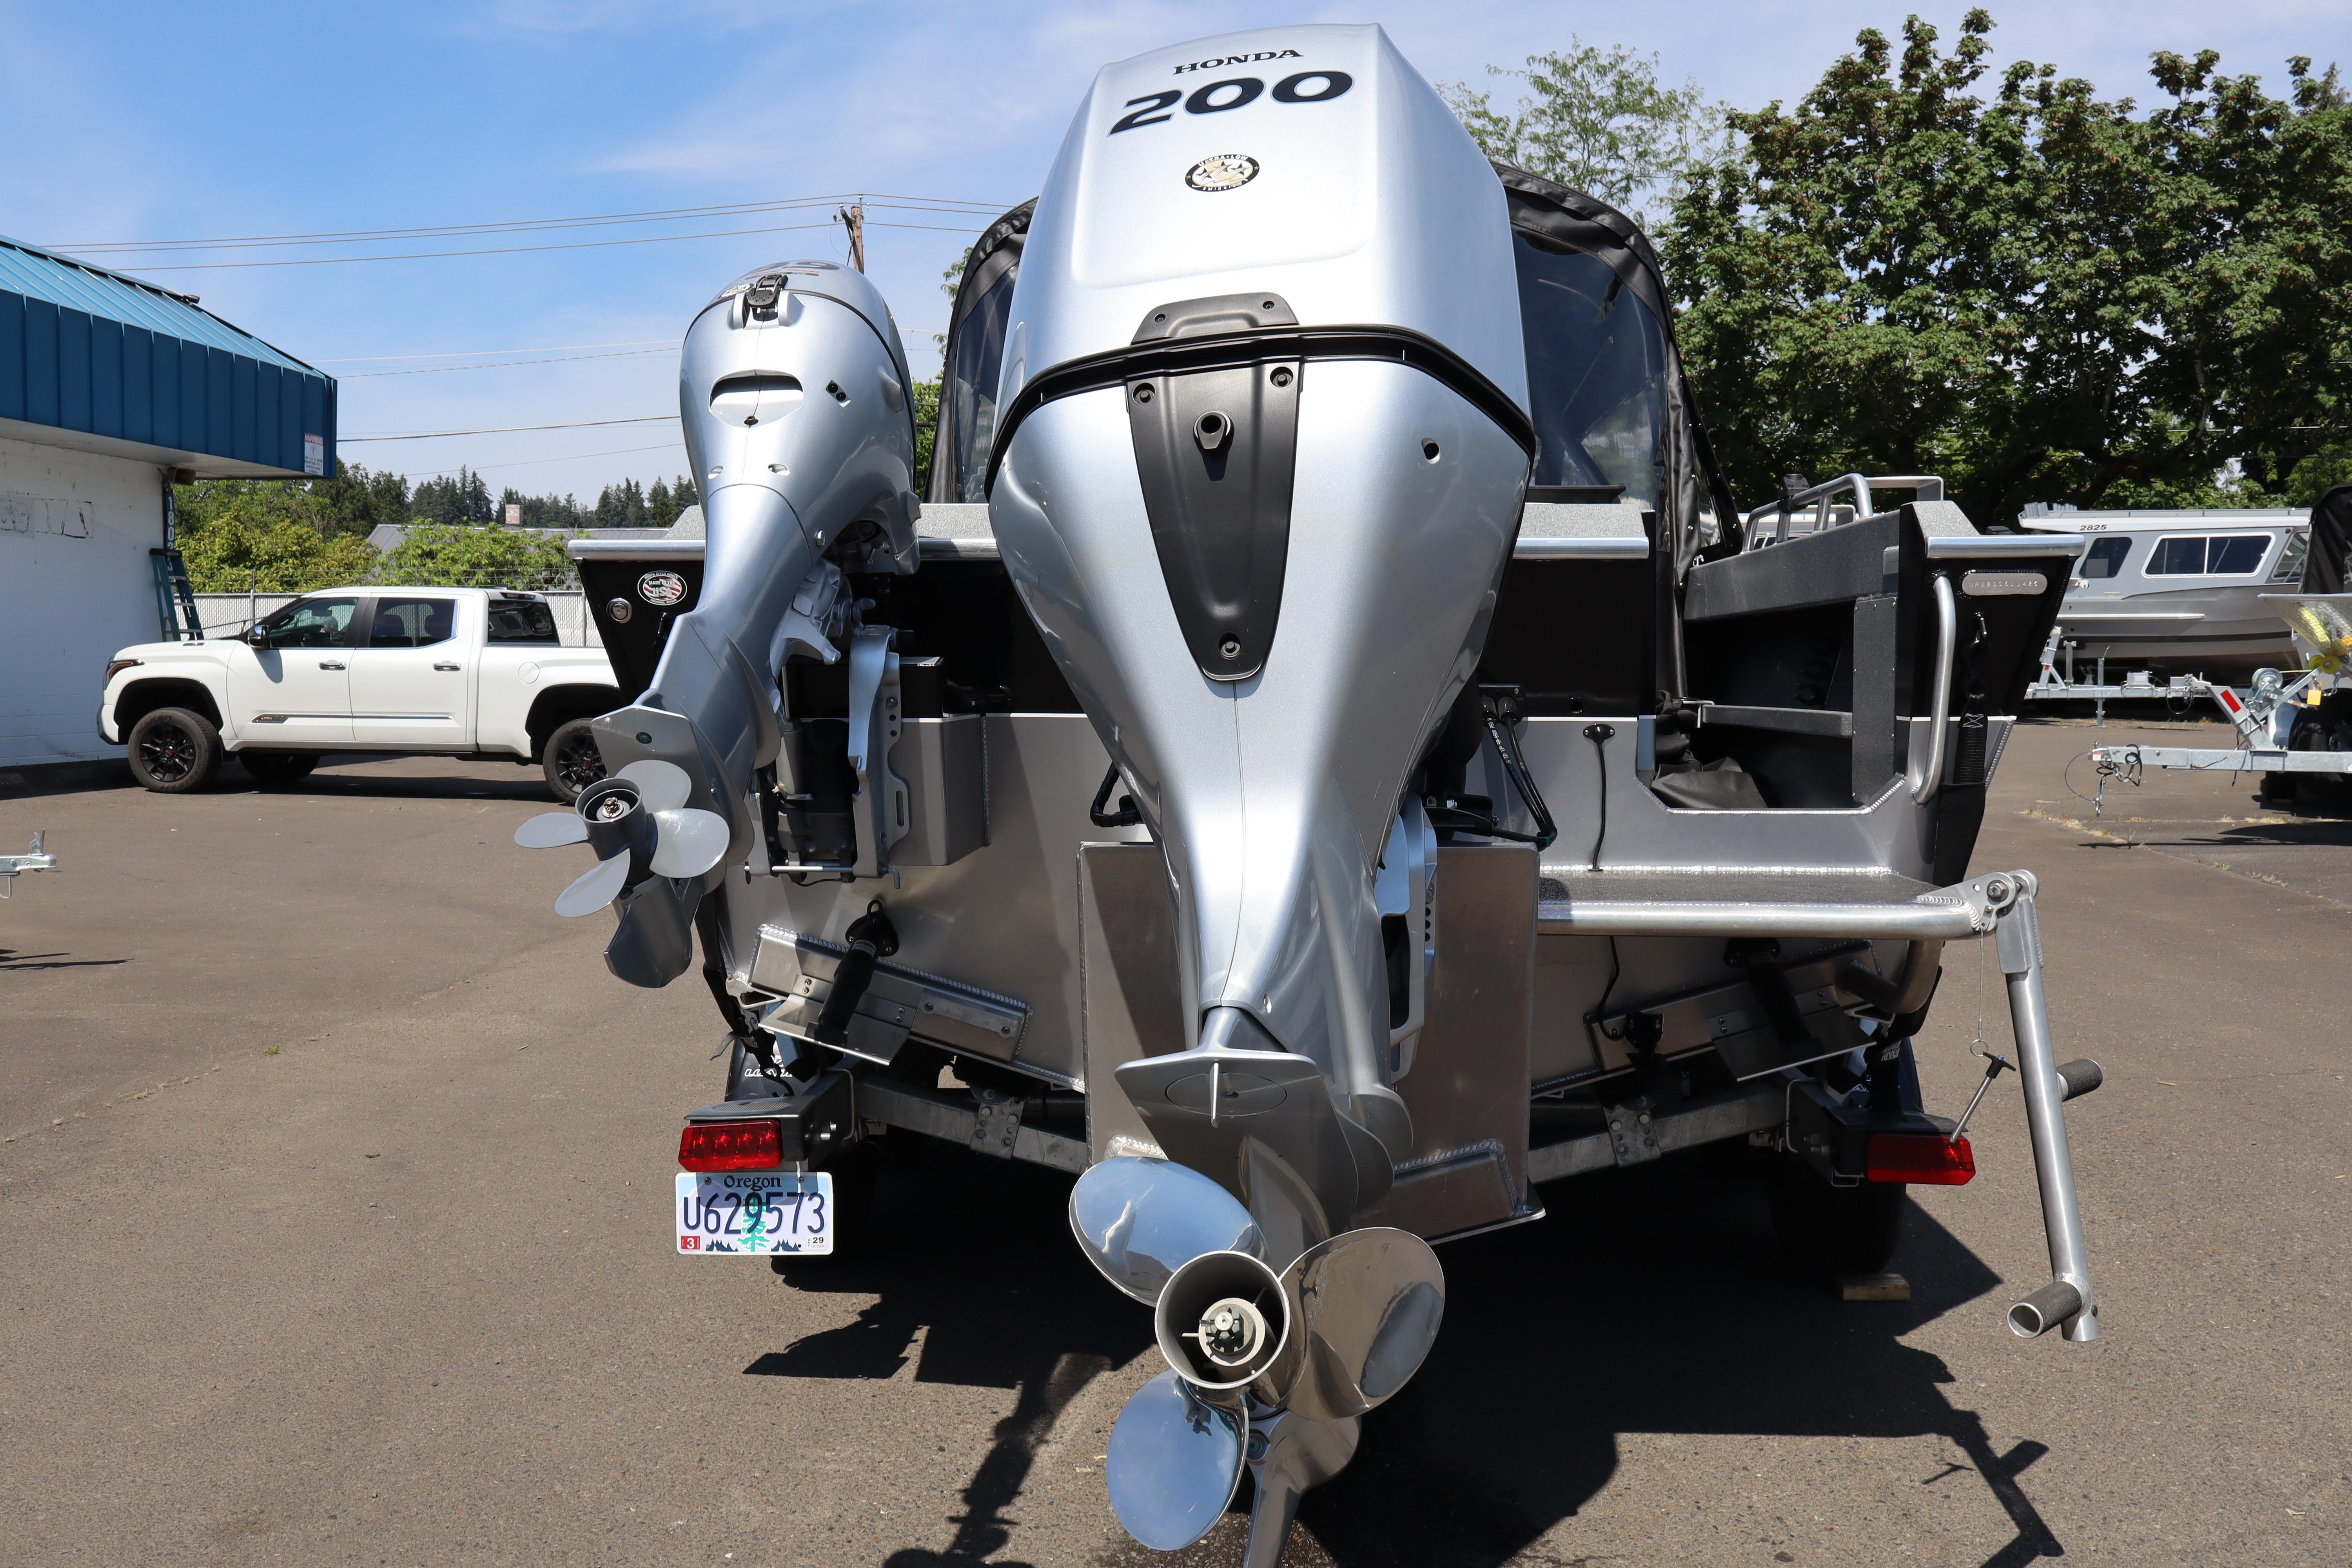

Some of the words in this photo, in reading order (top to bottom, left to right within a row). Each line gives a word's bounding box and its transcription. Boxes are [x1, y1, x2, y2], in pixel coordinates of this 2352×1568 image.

[1172, 49, 1304, 75] HONDA
[1107, 69, 1355, 137] 200
[652, 587, 673, 597] USA
[724, 1175, 783, 1191] Oregon
[684, 1192, 825, 1234] U629573
[686, 1238, 695, 1249] 3
